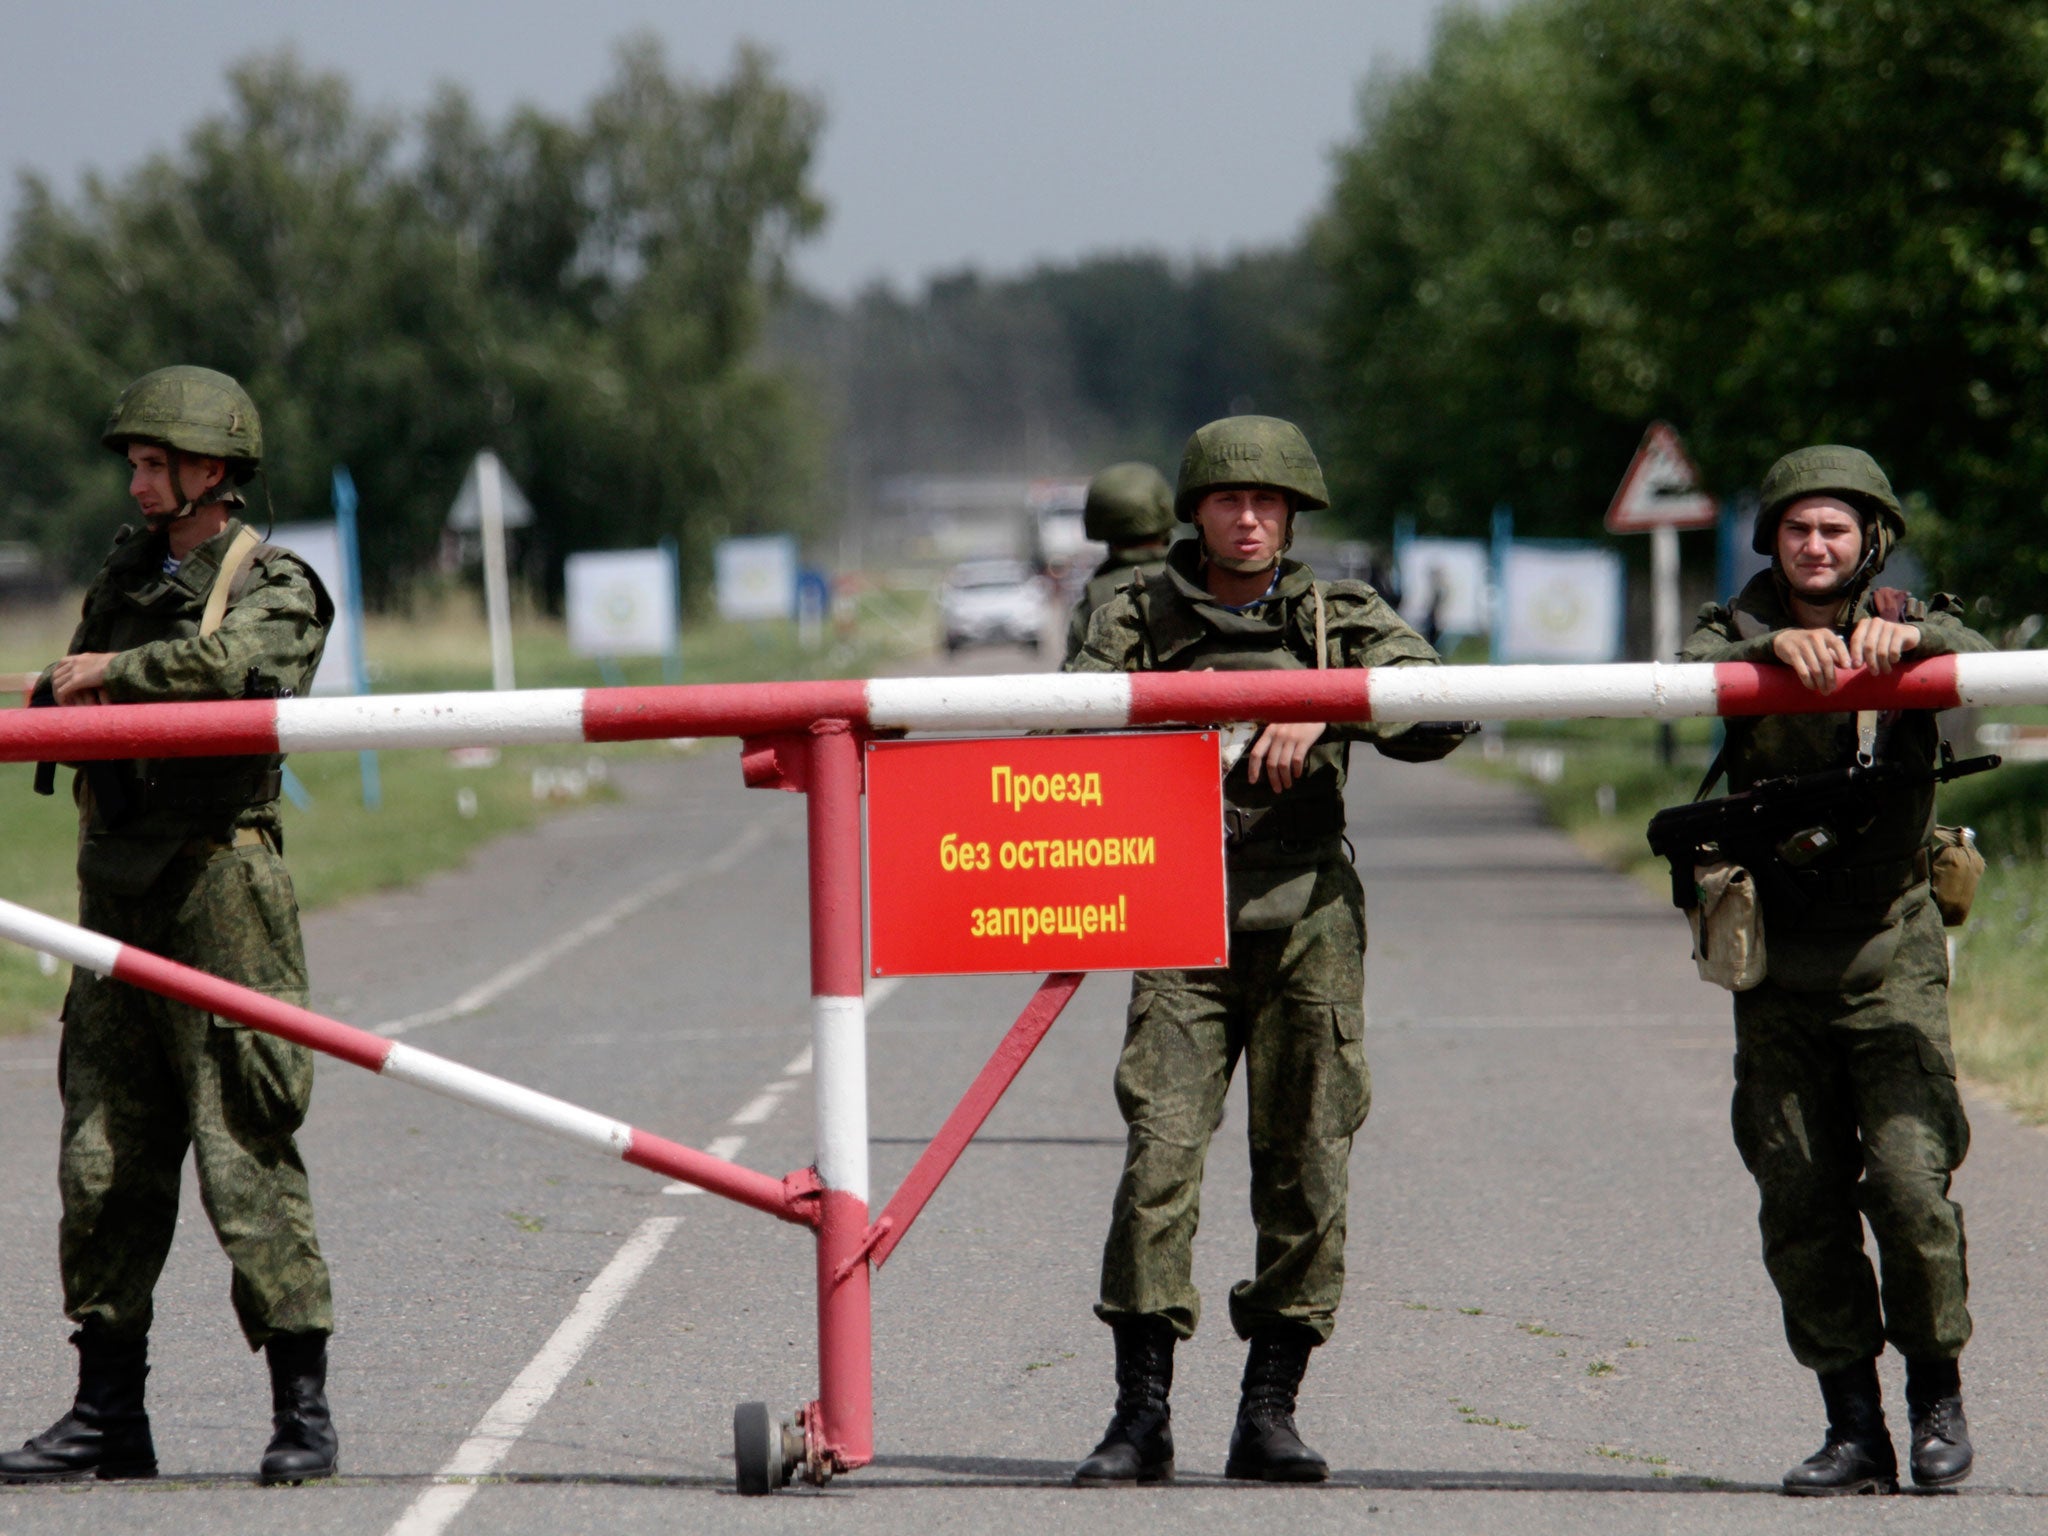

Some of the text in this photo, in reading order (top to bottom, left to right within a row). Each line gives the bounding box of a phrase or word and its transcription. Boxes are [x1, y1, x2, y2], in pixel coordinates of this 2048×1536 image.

[991, 766, 1103, 812] Проезд
[939, 833, 1155, 871] без остановки
[970, 895, 1126, 944] запрещен!
